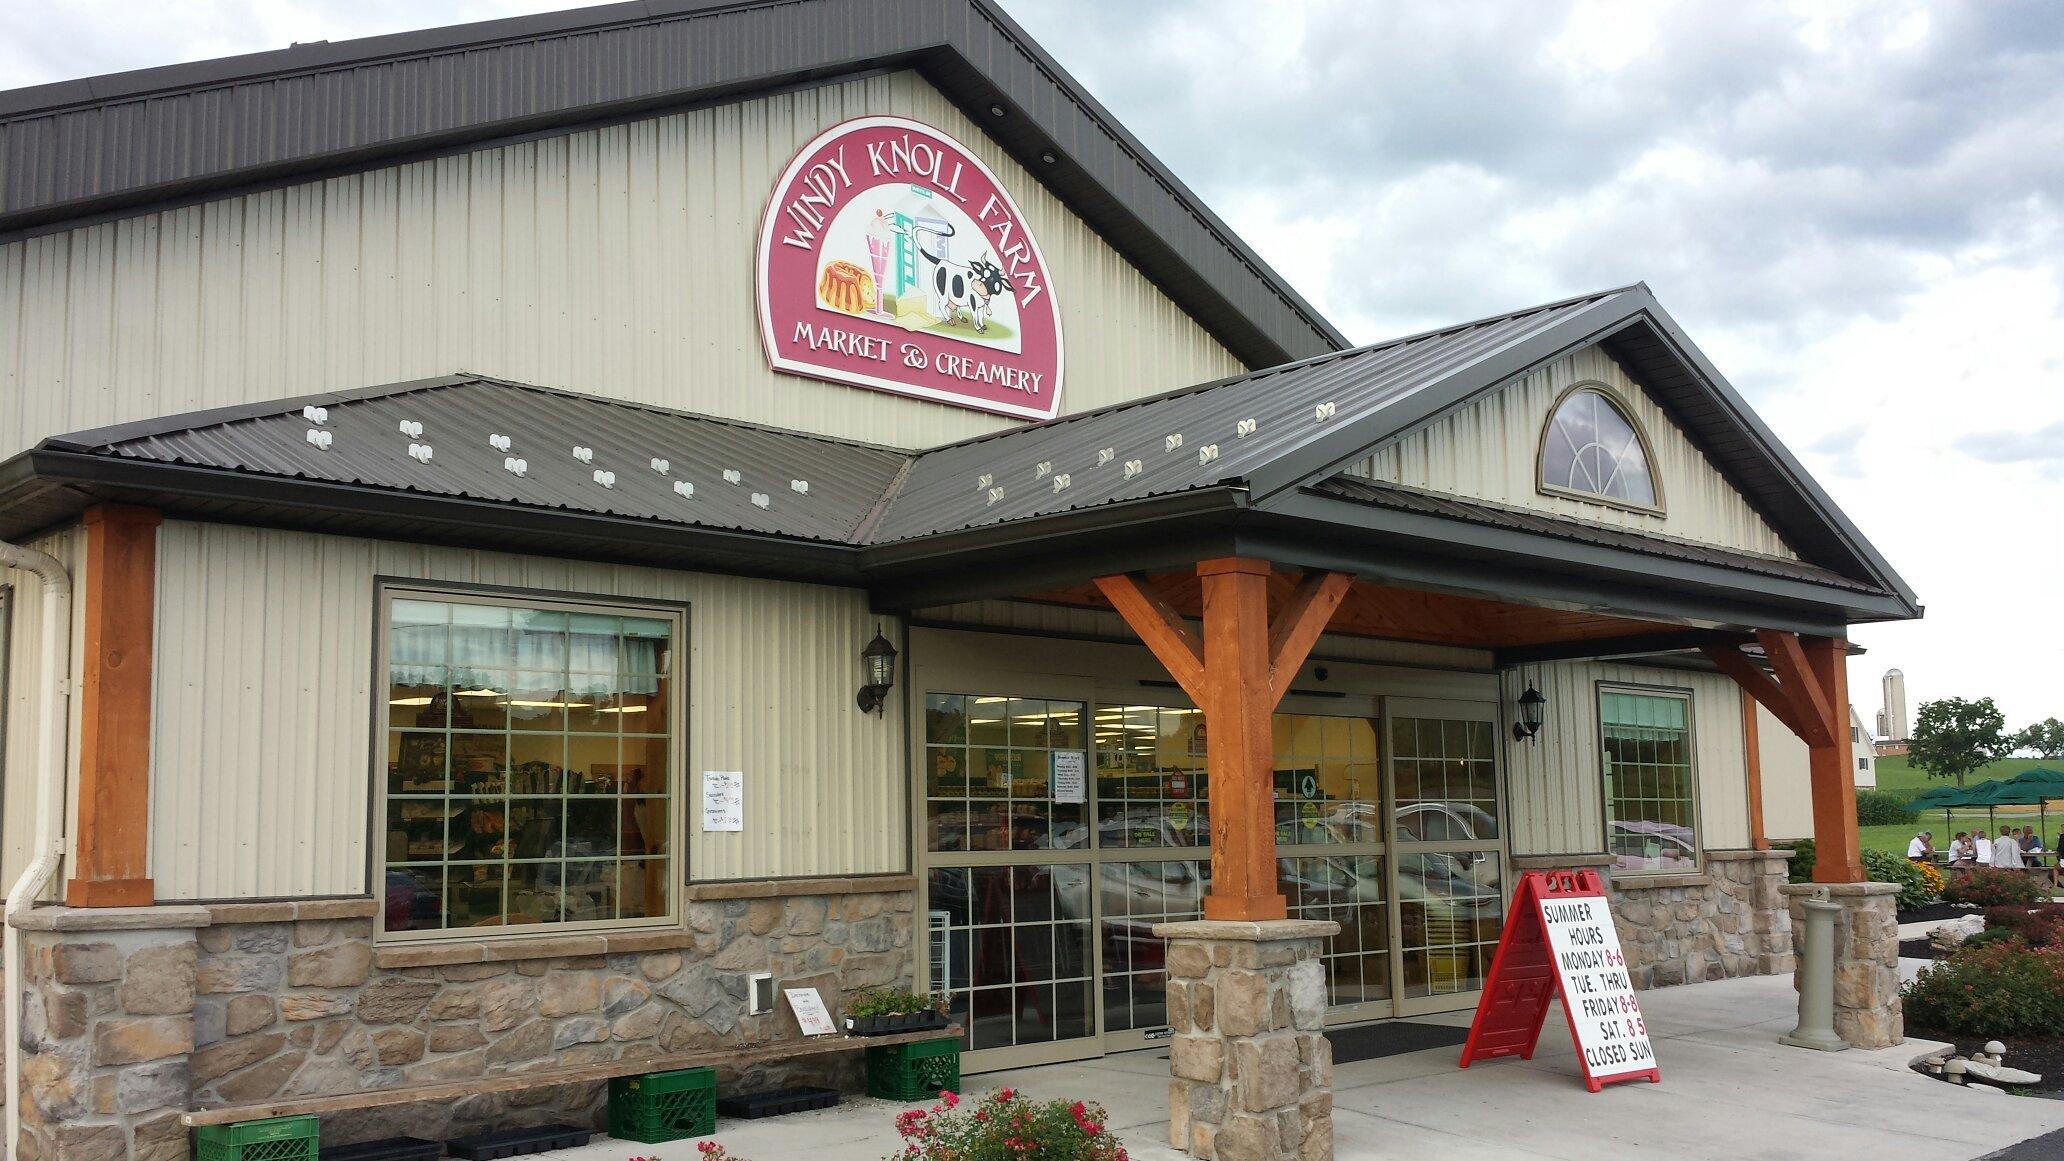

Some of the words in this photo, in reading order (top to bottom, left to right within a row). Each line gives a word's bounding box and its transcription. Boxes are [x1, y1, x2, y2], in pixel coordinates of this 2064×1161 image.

[783, 144, 853, 251] WINDY
[866, 134, 967, 203] KNOLL
[977, 192, 1042, 308] FARM
[793, 321, 892, 361] MARKET
[900, 344, 928, 369] &
[935, 351, 1043, 394] CREAMERY
[1544, 903, 1593, 924] SUMMER
[1568, 926, 1604, 946] HOURS
[1561, 949, 1605, 971] MONDAY
[1571, 974, 1597, 994] TUE.
[1600, 971, 1628, 991] THRU
[1582, 997, 1620, 1018] FRIDAY
[1600, 1020, 1626, 1040] SAT.
[1586, 1044, 1626, 1067] CLOSED
[1629, 1040, 1652, 1060] SUN
